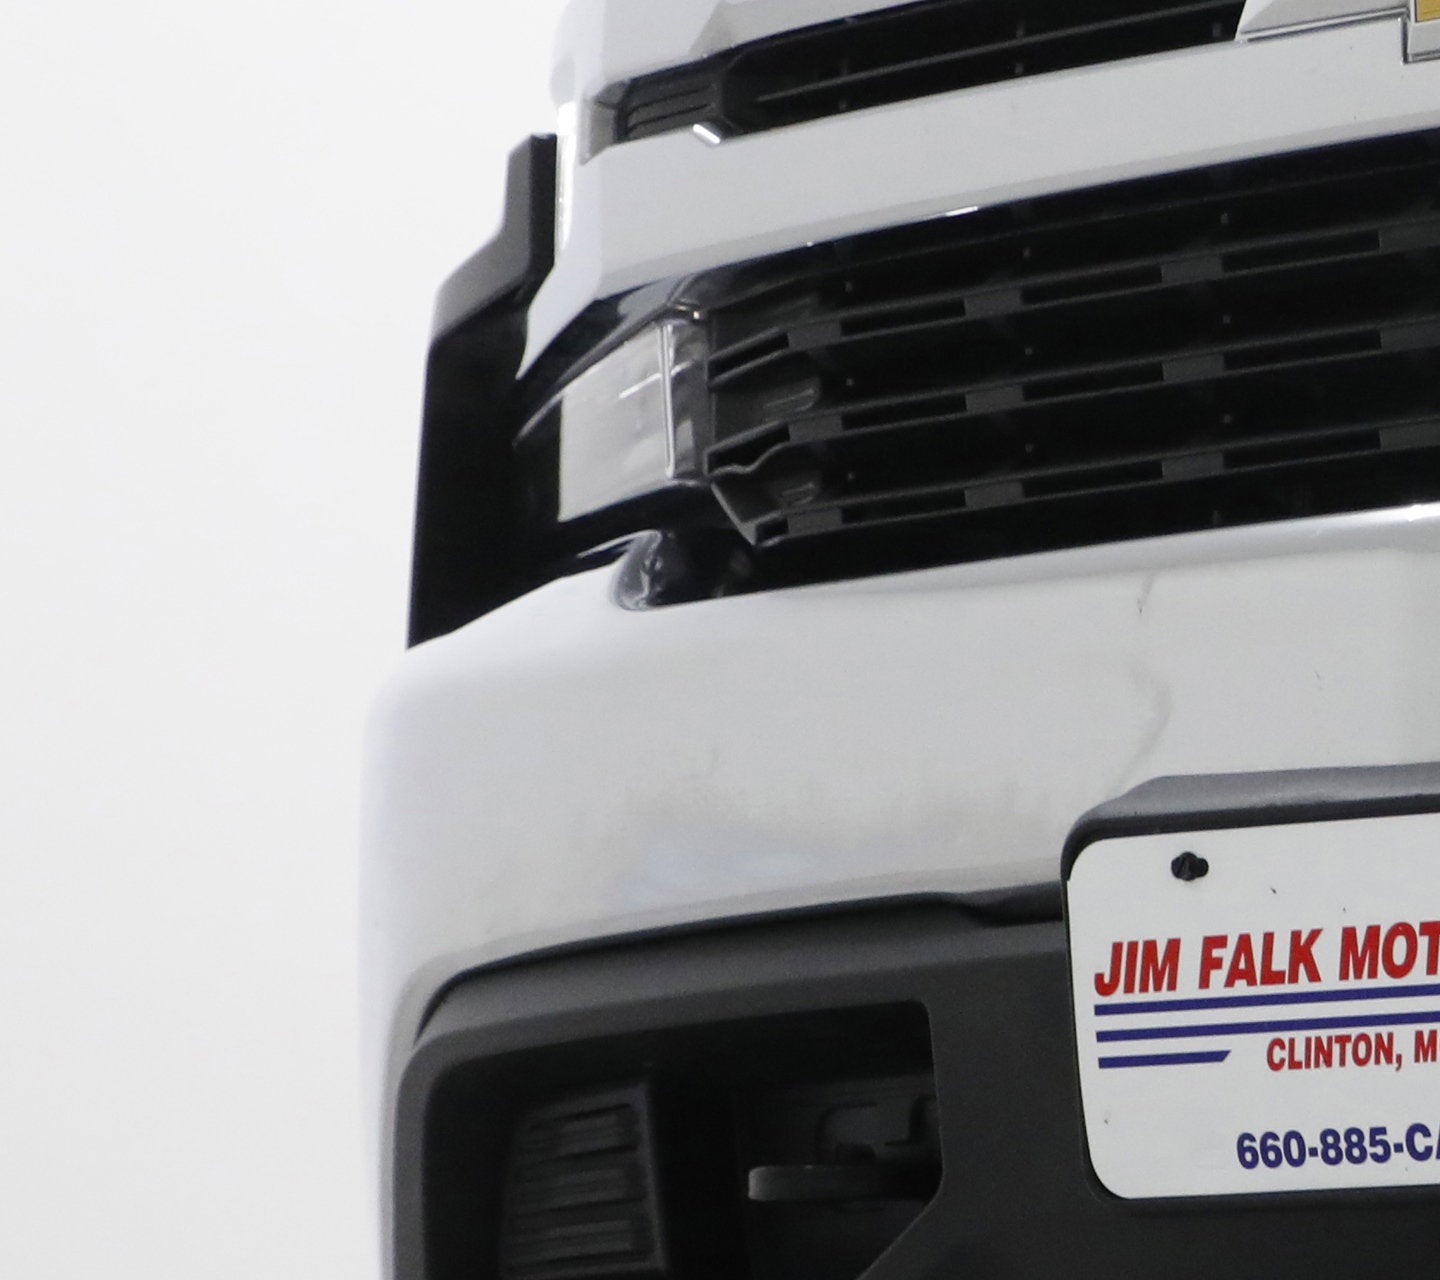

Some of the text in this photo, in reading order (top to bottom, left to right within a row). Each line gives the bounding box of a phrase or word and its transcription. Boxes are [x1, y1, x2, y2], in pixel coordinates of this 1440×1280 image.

[1094, 938, 1181, 997] JIM
[1199, 928, 1323, 990] FALK
[1267, 1032, 1402, 1072] CLINTON,
